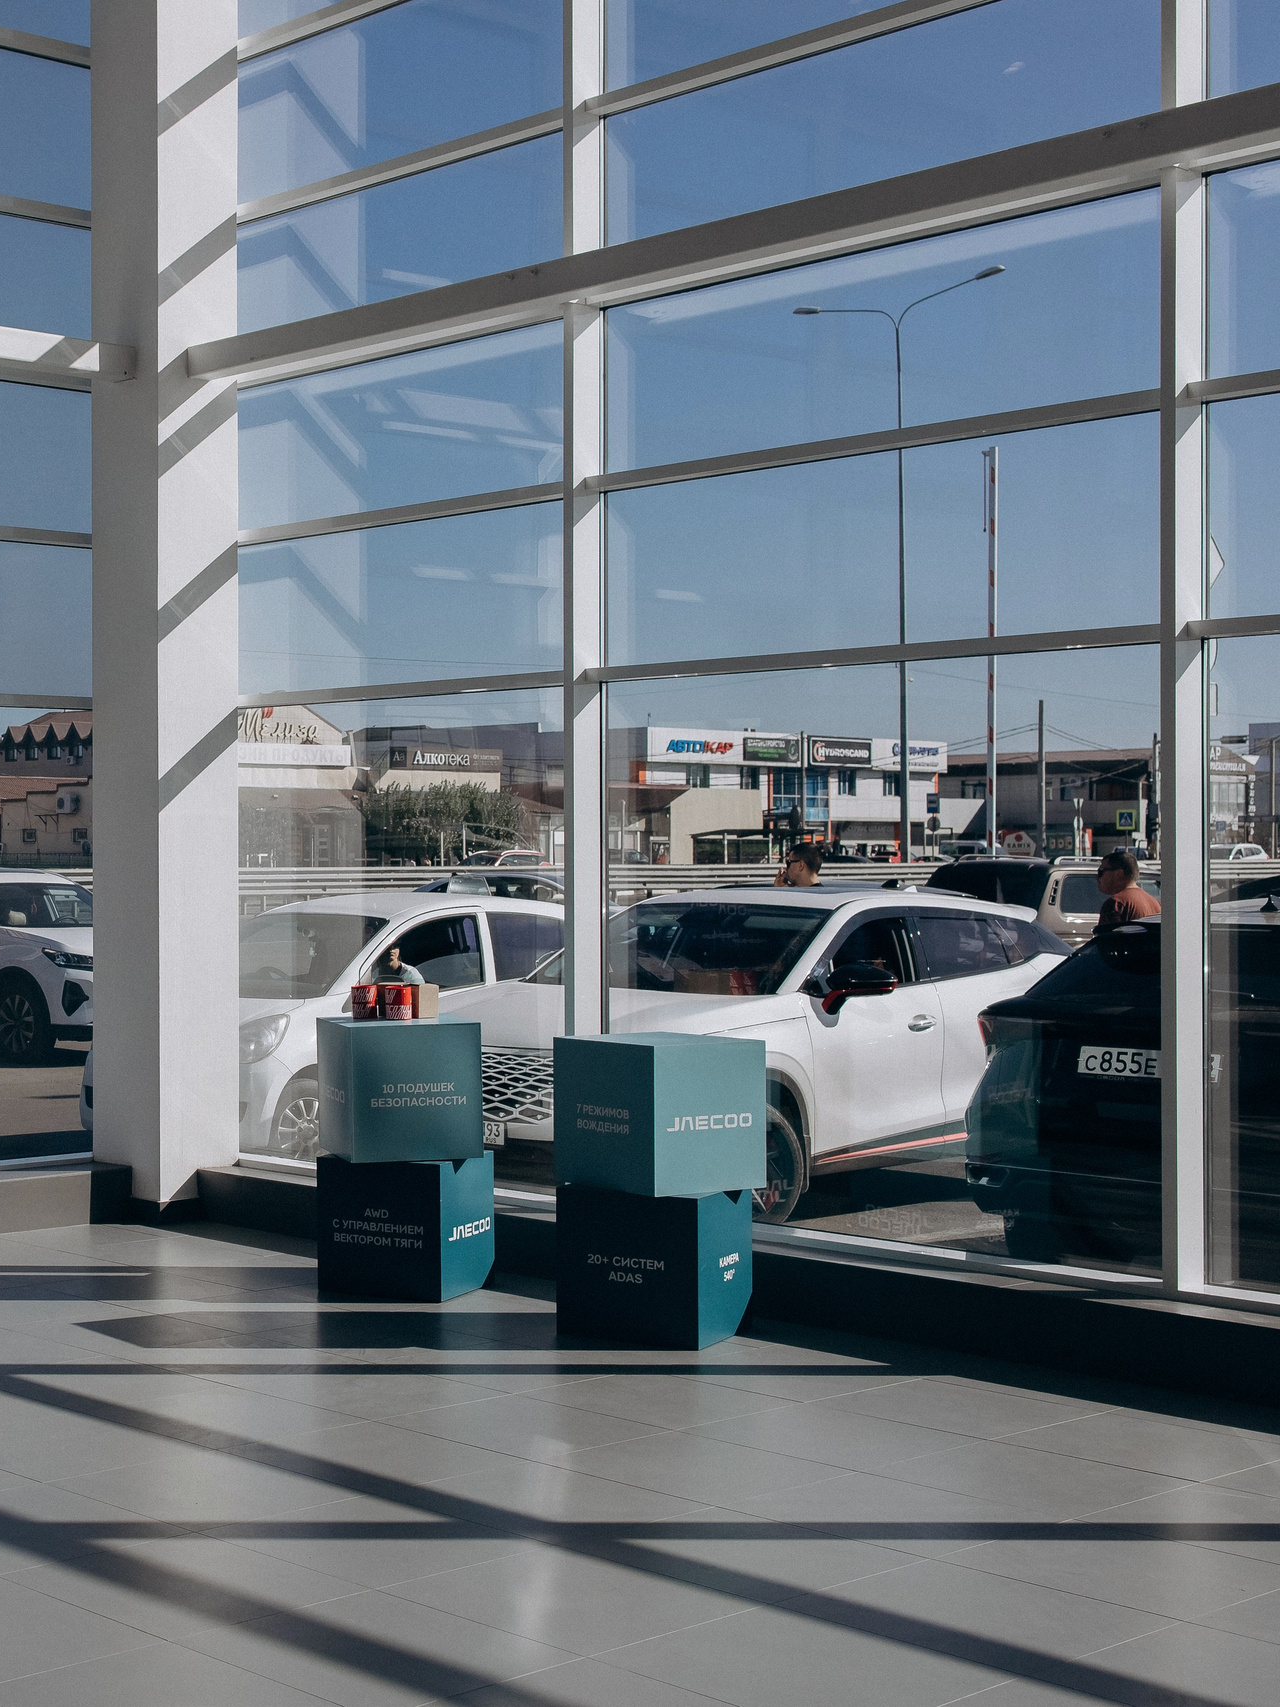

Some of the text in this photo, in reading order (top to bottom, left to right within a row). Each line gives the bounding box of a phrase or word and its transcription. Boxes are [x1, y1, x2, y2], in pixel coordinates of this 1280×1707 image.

[272, 748, 349, 764] ПРОДУКТЫ
[817, 746, 870, 758] HYDROSCAND
[382, 1081, 455, 1095] 10 ПОДУШЕК
[370, 1095, 467, 1109] БЕЗОПАСНОСТИ
[576, 1103, 630, 1120] 7 РЕЖИМОВ
[576, 1119, 630, 1135] ВОЖДЕНИЯ
[666, 1112, 753, 1132] JAECOO
[364, 1208, 389, 1219] AWD
[343, 1219, 425, 1236] УПРАВЛЕНИЕМ
[448, 1217, 491, 1242] JAECOO
[334, 1233, 424, 1249] ВЕКТОРОМ ТЯГИ
[587, 1253, 665, 1271] 20+ СИСТЕМ
[719, 1252, 740, 1269] КАМЕРА
[608, 1271, 643, 1285] ADAS
